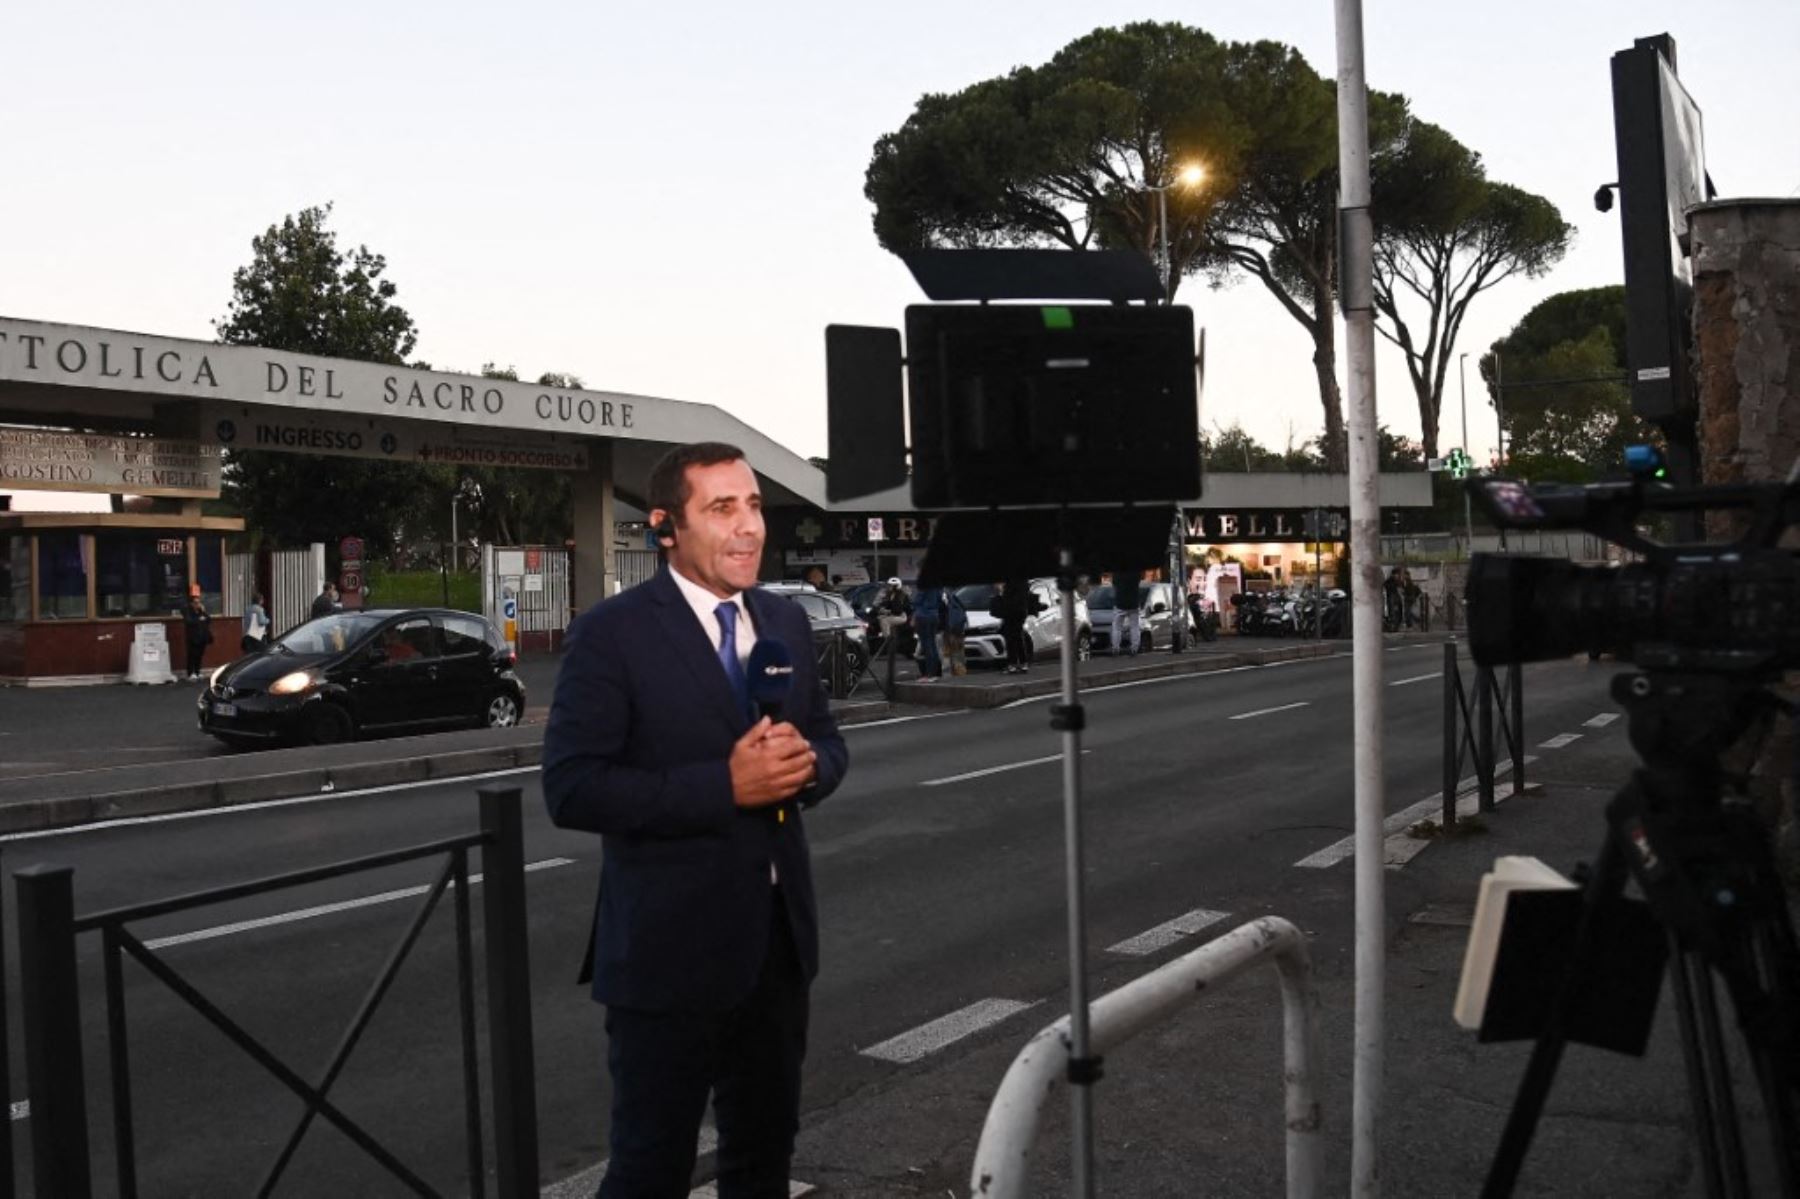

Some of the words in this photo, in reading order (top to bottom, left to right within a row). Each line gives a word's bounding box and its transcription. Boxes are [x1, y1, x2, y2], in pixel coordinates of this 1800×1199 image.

[0, 332, 219, 388] TOLICA
[265, 361, 344, 399] DEL
[383, 376, 504, 414] SACRO
[535, 394, 634, 428] CUORE
[256, 424, 362, 450] INGRESSO
[434, 446, 497, 463] PRONTO
[499, 449, 571, 467] SOCCORSO
[1184, 514, 1308, 537] MELL
